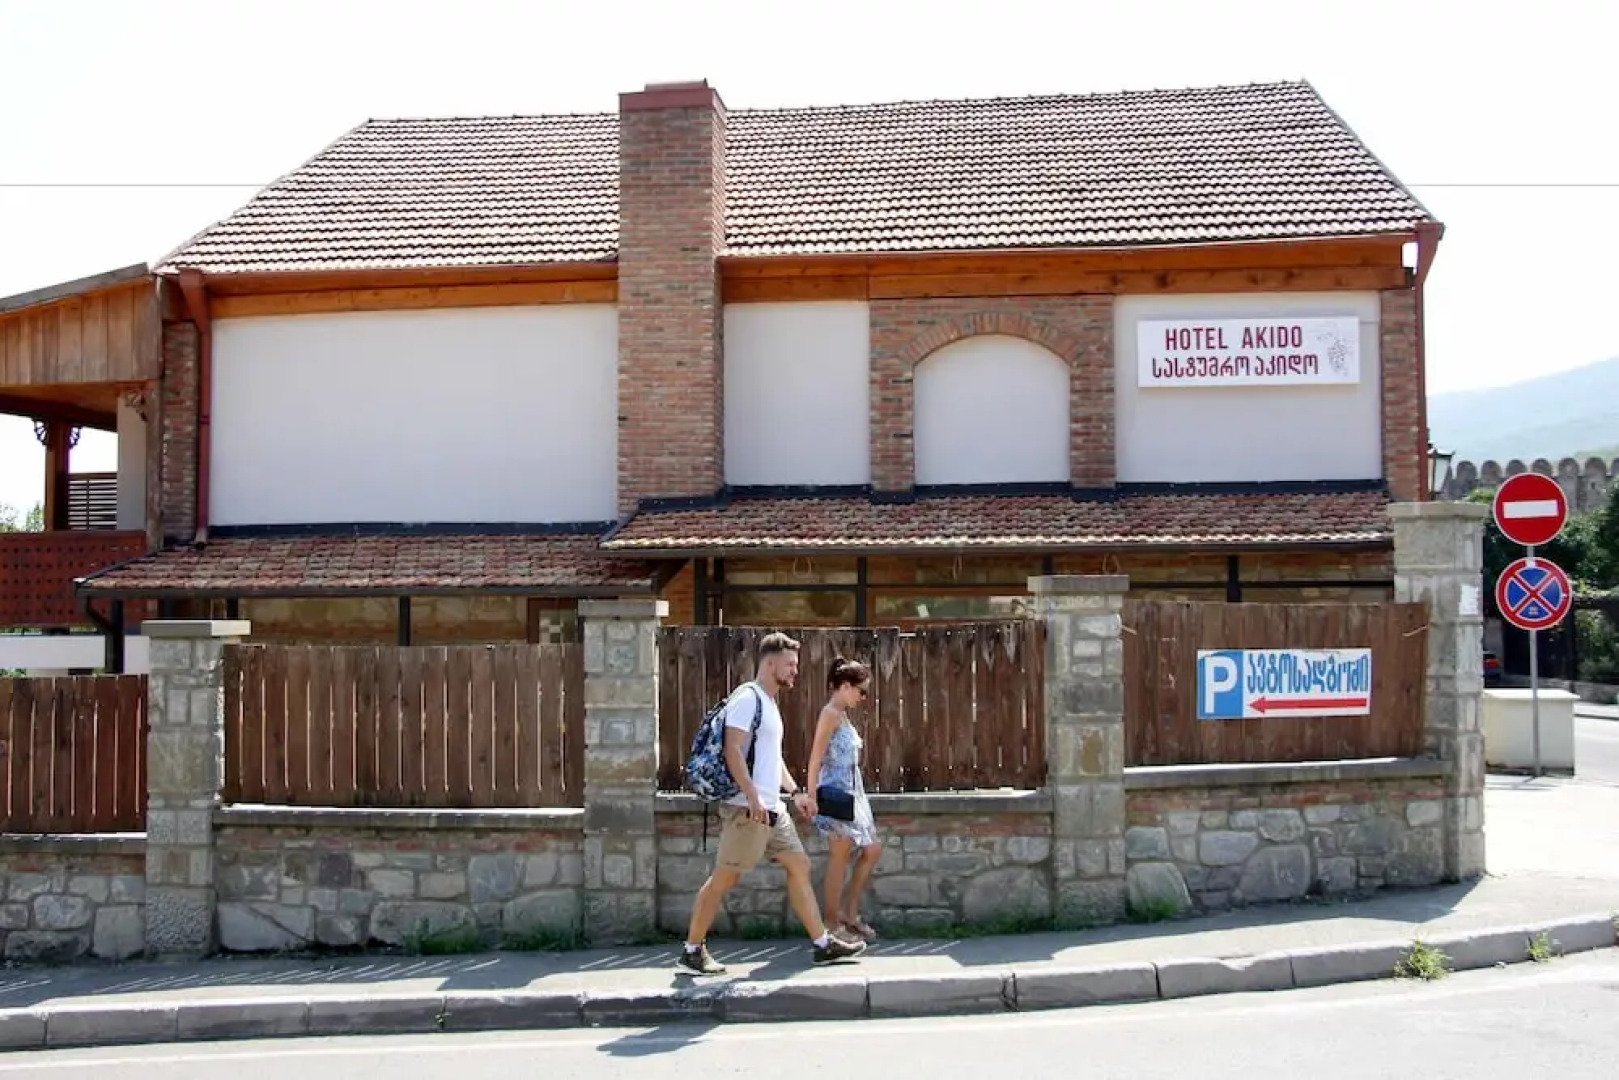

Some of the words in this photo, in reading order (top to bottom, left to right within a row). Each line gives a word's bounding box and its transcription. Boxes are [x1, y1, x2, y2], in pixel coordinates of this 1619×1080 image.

[1165, 327, 1229, 350] HOTEL
[1241, 325, 1303, 349] AKIDO
[1152, 355, 1250, 378] სასტუმრო
[1254, 354, 1319, 377] აკიდო
[1204, 655, 1238, 714] P
[1247, 653, 1369, 694] ავტოსადგომი
